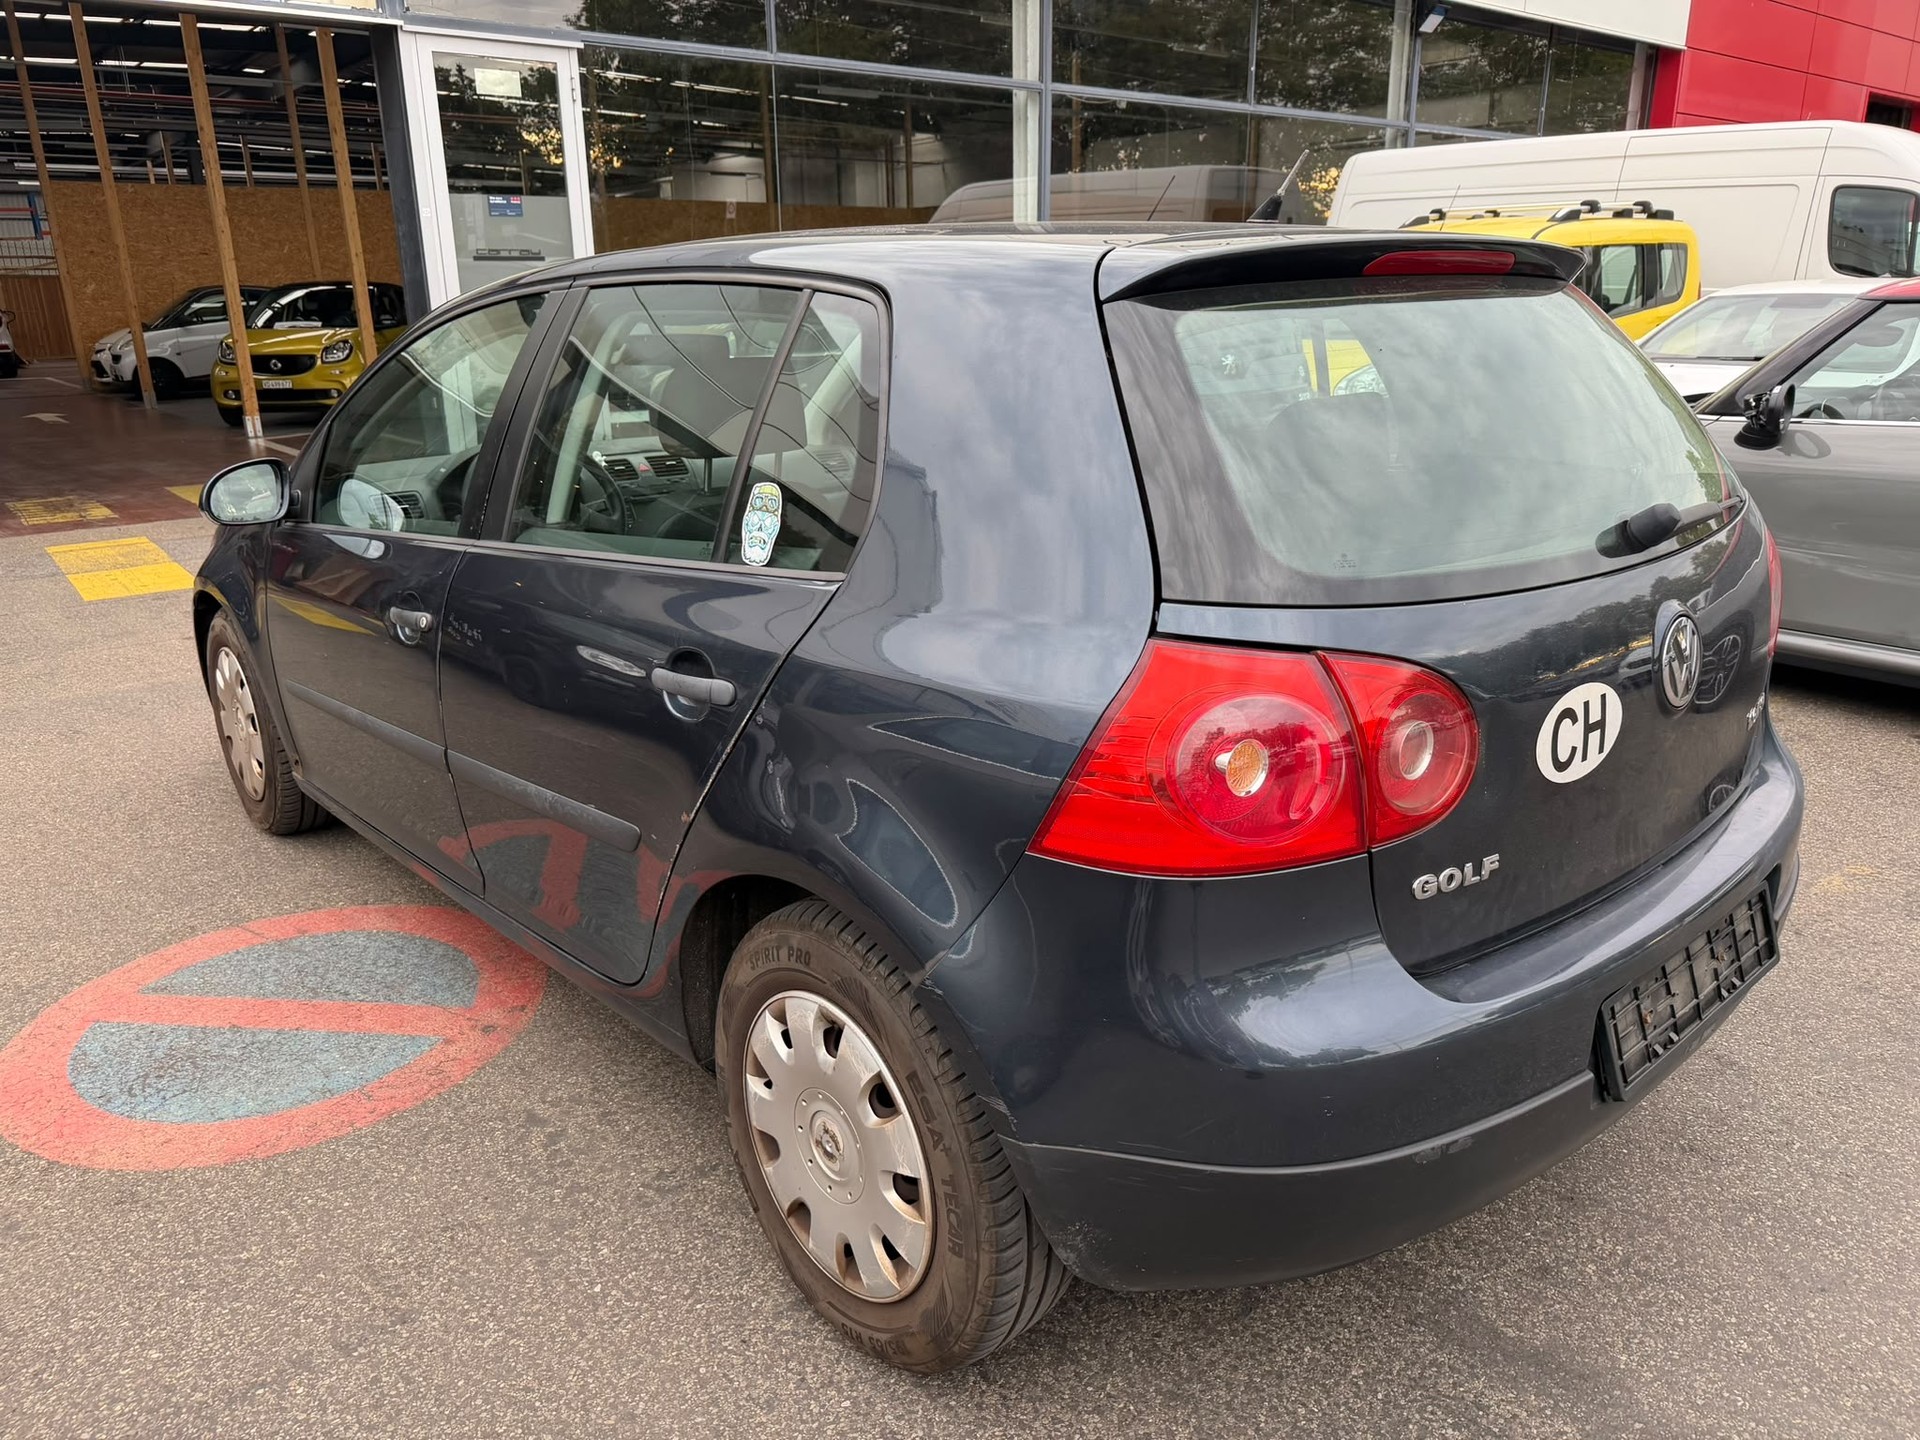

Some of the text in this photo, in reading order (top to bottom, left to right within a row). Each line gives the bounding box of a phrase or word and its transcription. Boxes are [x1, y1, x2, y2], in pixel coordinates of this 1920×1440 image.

[1551, 693, 1607, 773] CH
[1412, 853, 1500, 900] GOLF
[748, 944, 811, 971] SPIRIT PRO
[940, 1174, 964, 1259] TECAR
